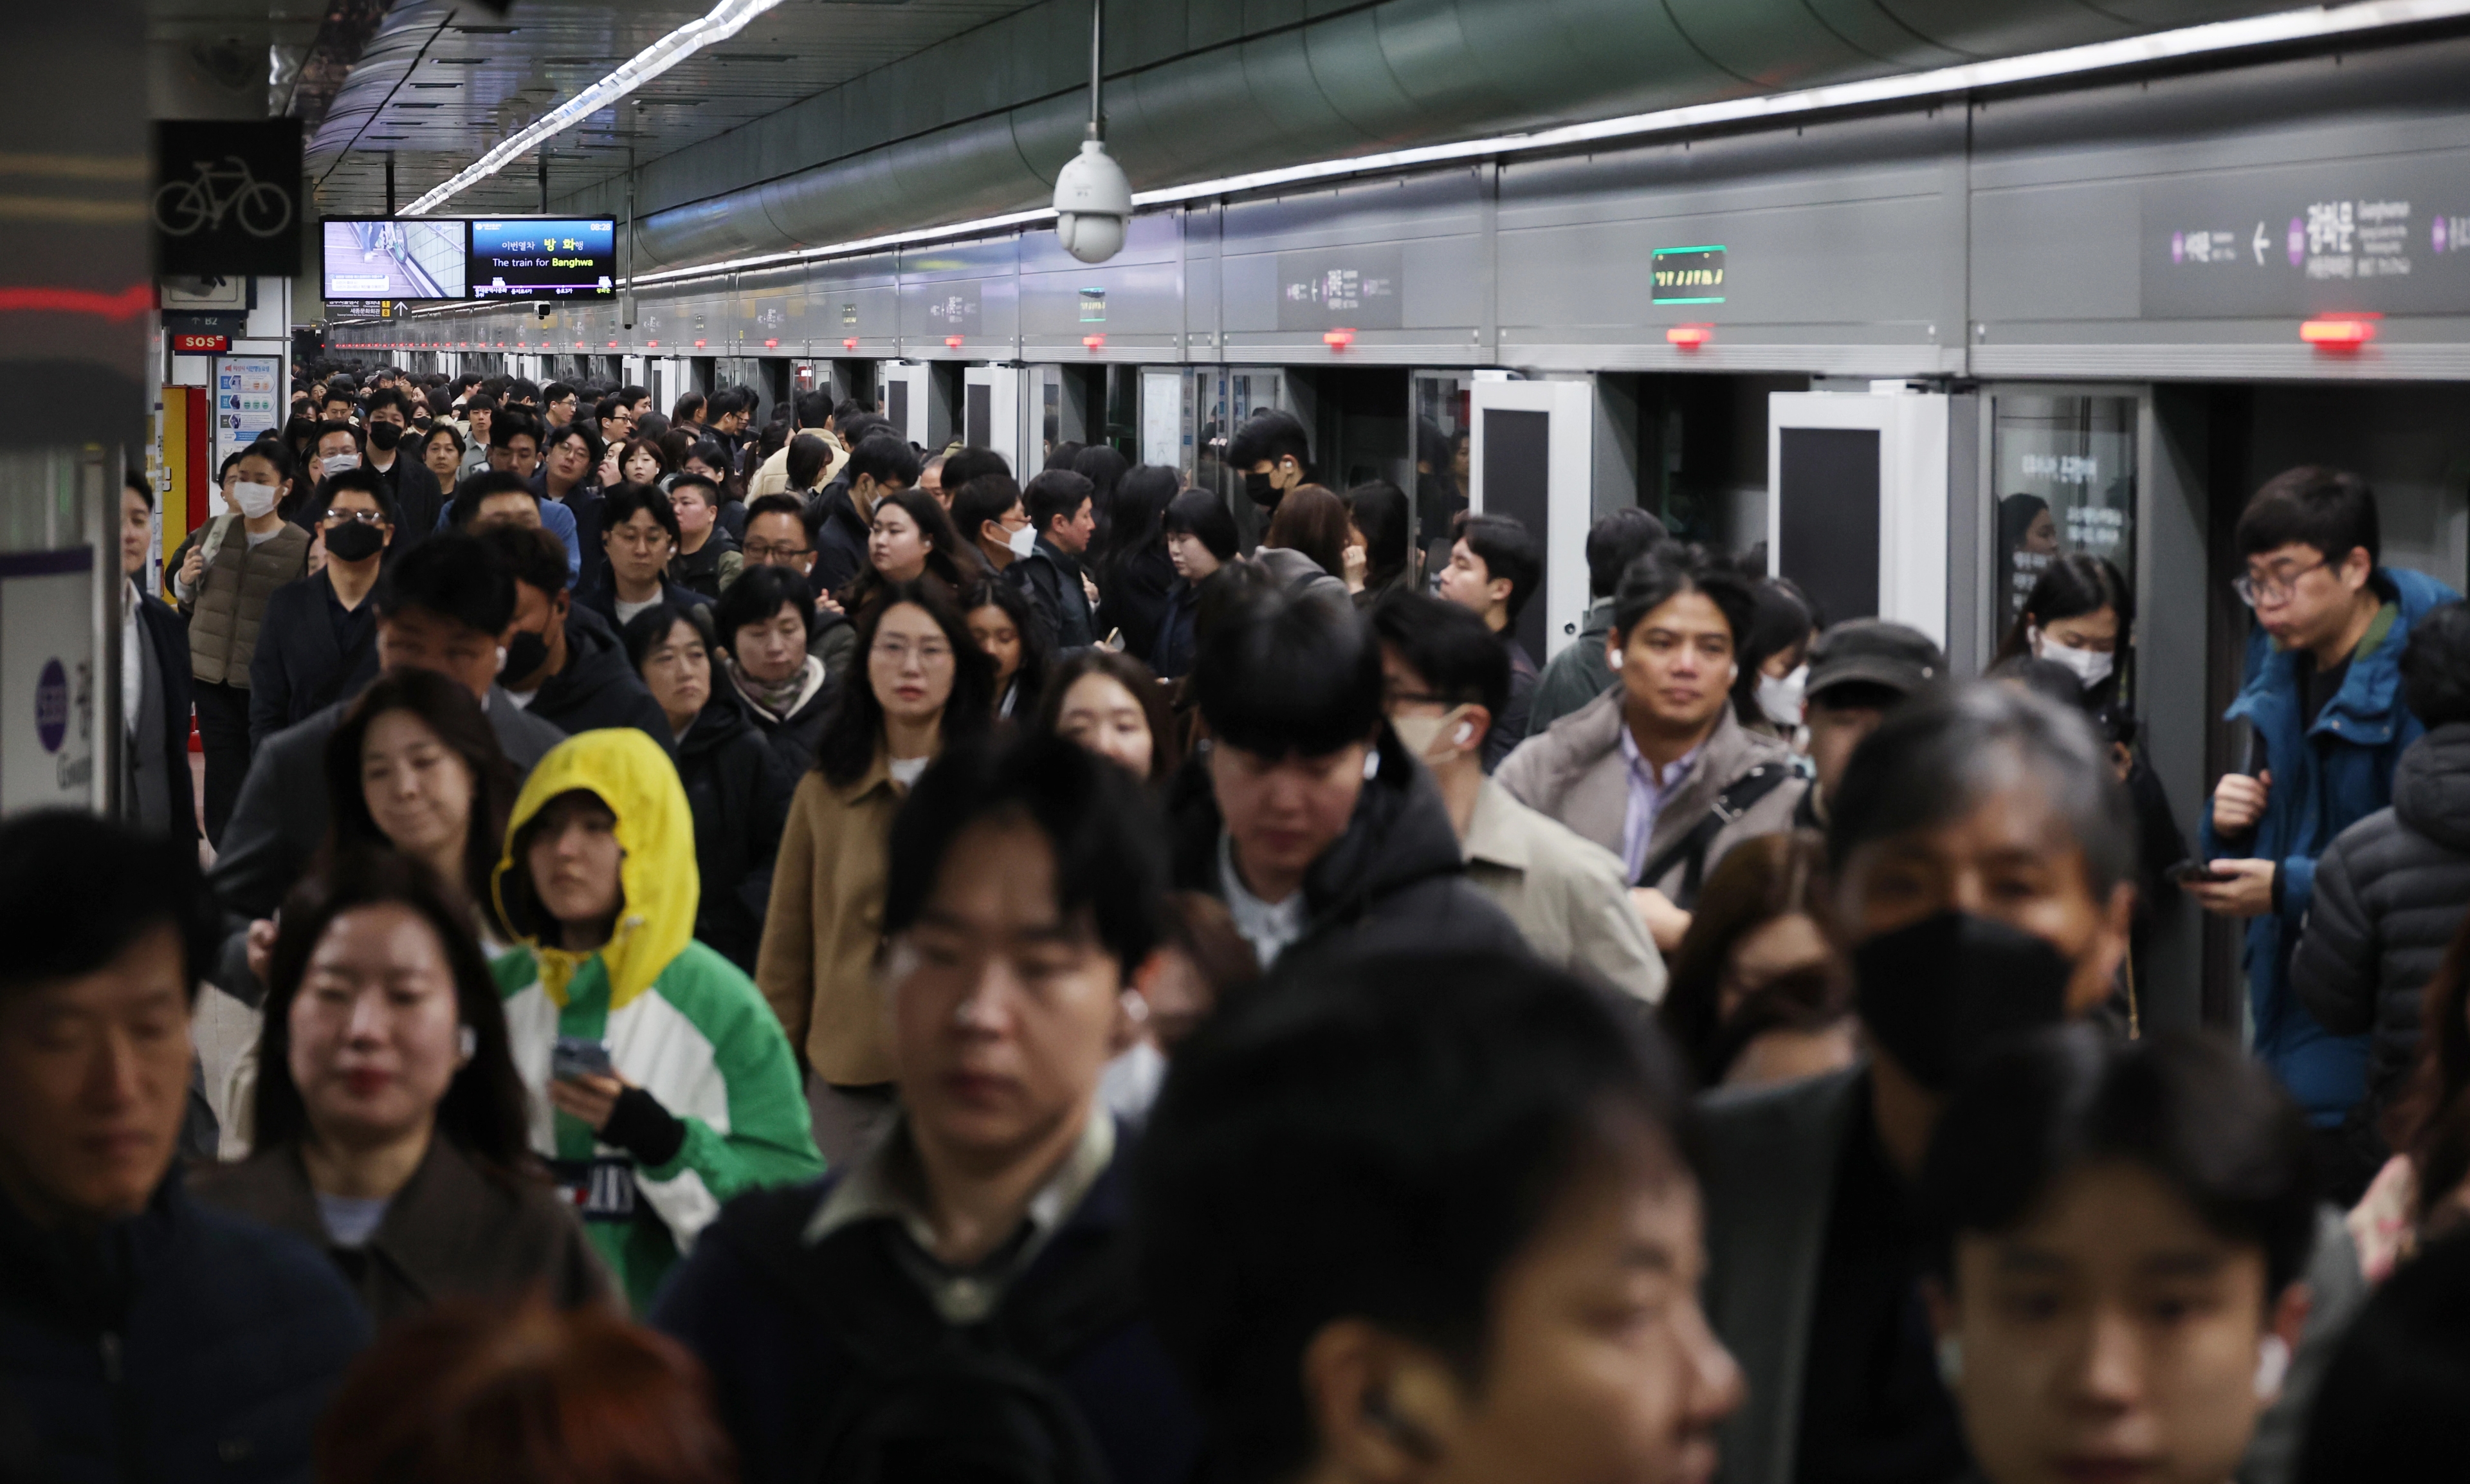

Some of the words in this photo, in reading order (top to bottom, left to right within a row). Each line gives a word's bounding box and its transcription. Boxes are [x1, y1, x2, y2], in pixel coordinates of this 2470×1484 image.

[502, 241, 536, 251] 이번열차
[493, 258, 509, 267] The
[512, 258, 533, 267] train
[536, 258, 549, 267] for
[552, 258, 593, 268] Banghwa
[186, 336, 215, 347] SOS
